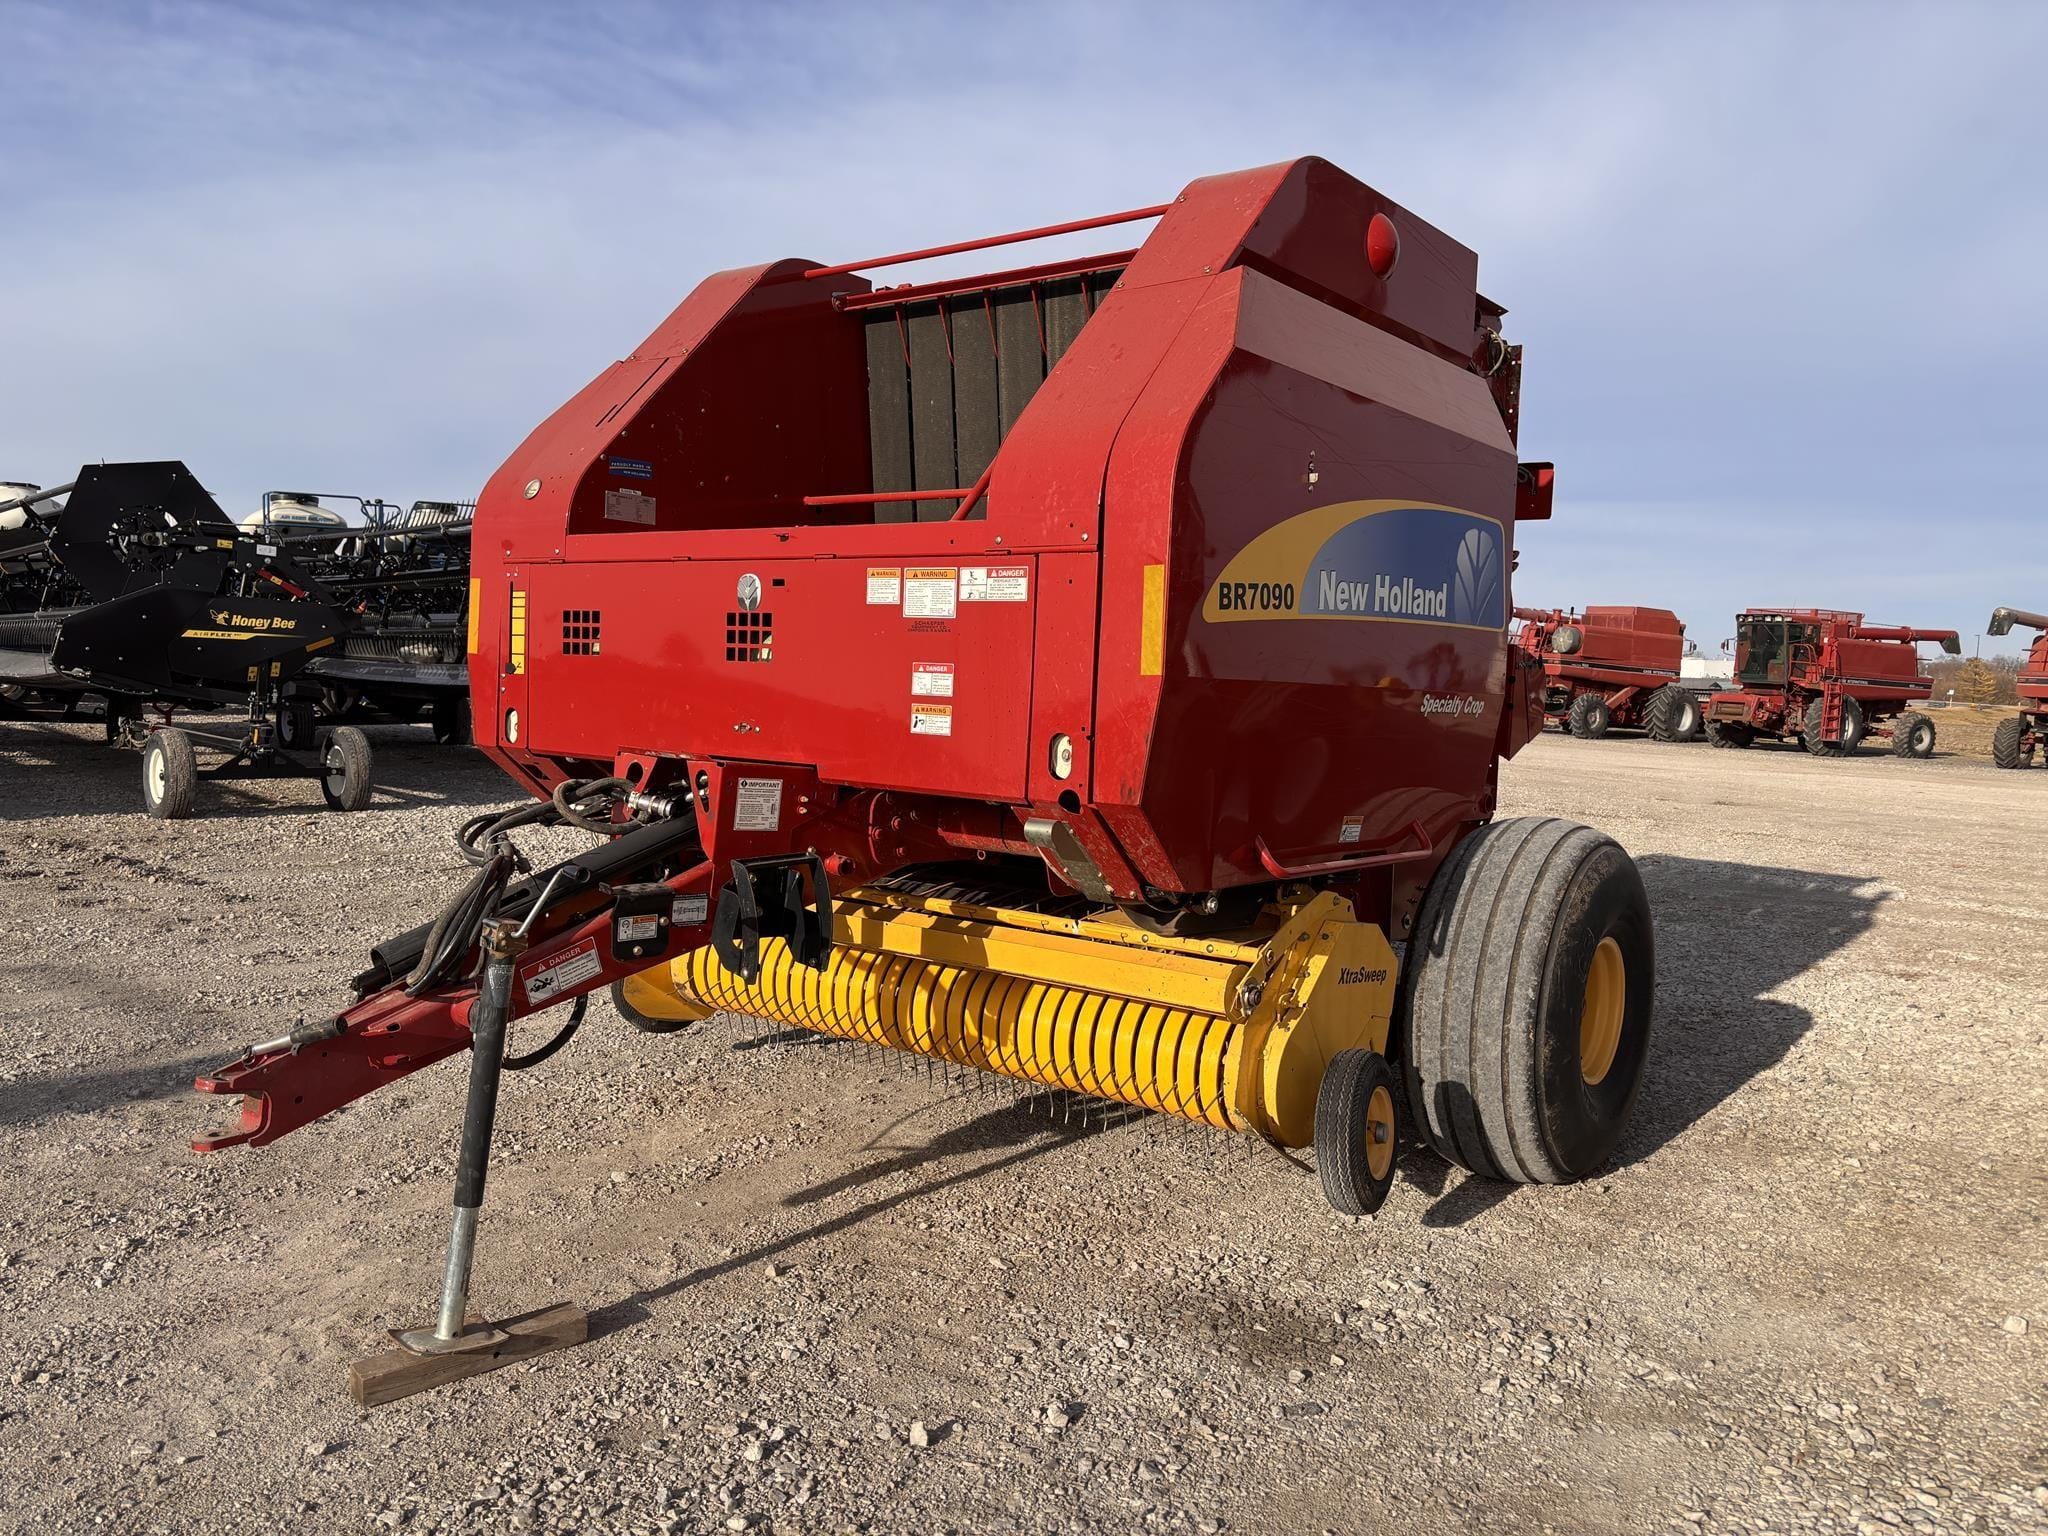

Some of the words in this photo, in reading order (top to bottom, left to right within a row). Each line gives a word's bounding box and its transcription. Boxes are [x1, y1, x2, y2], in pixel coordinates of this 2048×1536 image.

[920, 570, 948, 578] WARNING
[998, 569, 1024, 577] DANGER
[1218, 582, 1295, 611] BR7090
[1317, 569, 1369, 612] New
[1374, 574, 1447, 618] Holland
[230, 614, 271, 630] Honey
[271, 616, 296, 629] Bee
[925, 665, 948, 673] DANGER
[921, 706, 947, 714] WARNING
[1420, 693, 1464, 718] Specialty
[1464, 695, 1485, 718] Crop
[549, 946, 581, 967] DANGER
[1337, 965, 1387, 986] XtraSweep
